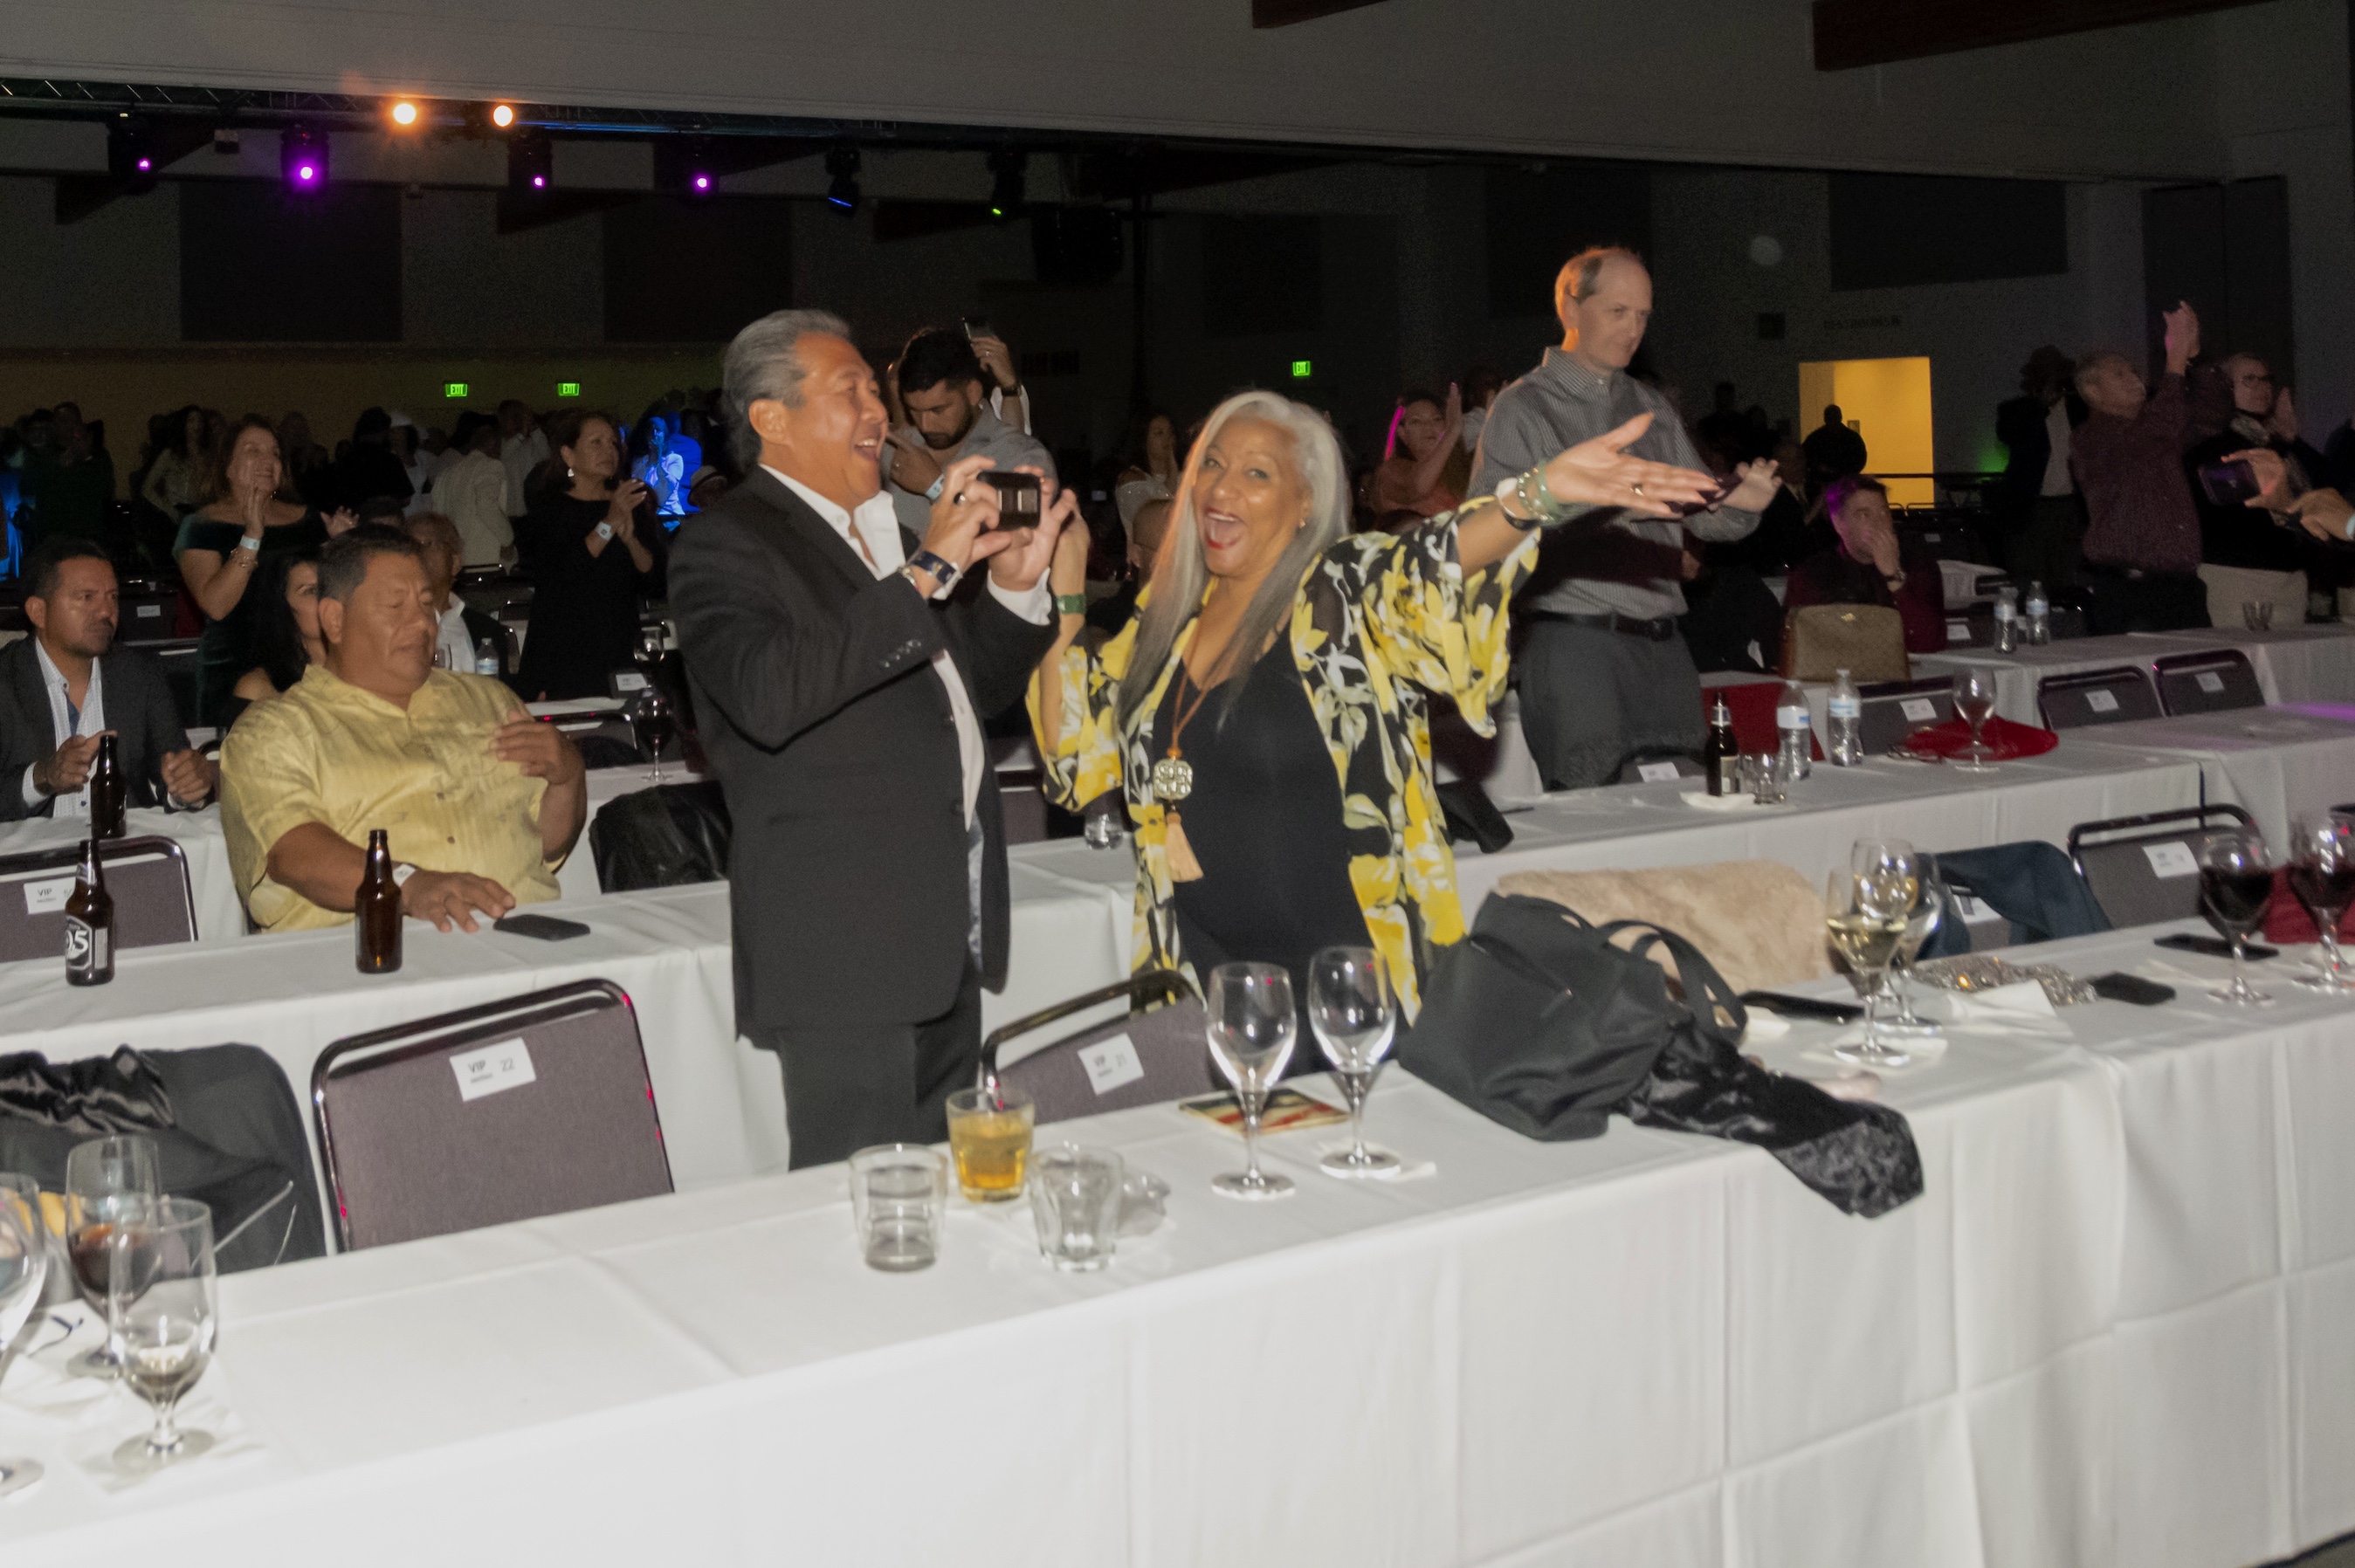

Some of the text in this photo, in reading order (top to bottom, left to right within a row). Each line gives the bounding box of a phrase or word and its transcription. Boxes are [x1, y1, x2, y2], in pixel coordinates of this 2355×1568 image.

[451, 384, 464, 395] EXIT
[563, 383, 576, 394] EXIT
[38, 888, 52, 897] VIP
[468, 1057, 514, 1073] VIP 22
